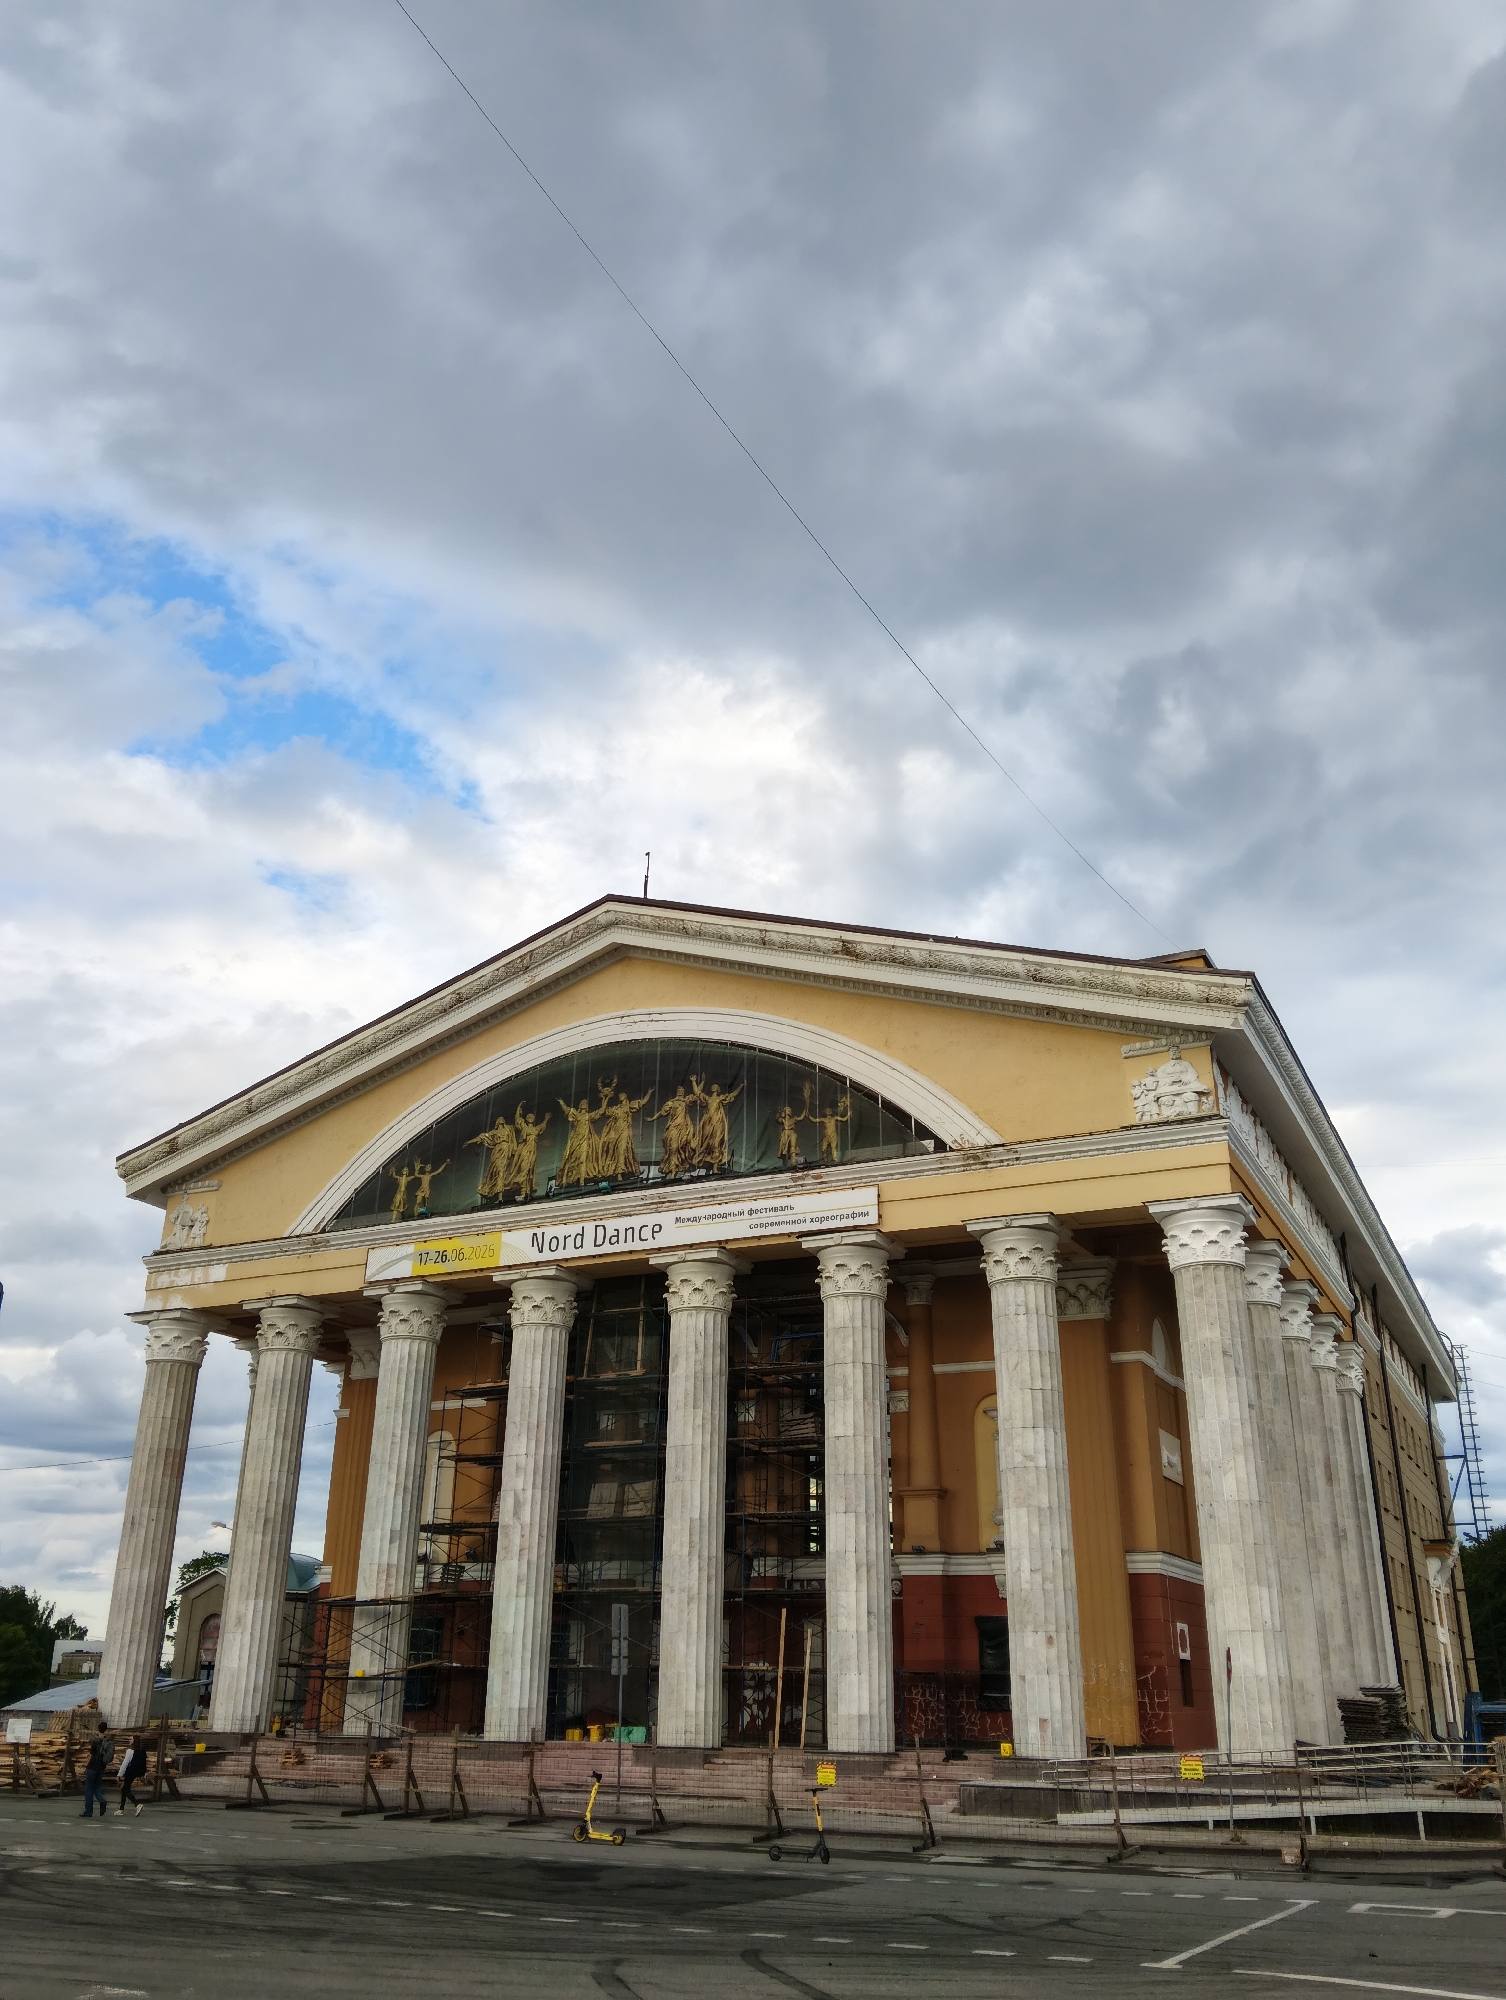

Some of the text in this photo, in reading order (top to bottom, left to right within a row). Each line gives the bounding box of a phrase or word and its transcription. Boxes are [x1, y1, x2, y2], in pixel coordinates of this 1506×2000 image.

[674, 1204, 795, 1224] Международный фестиваль
[748, 1210, 870, 1230] современной хореографии
[531, 1223, 663, 1254] Nord Dance
[418, 1243, 495, 1267] 17-26.06.2026
